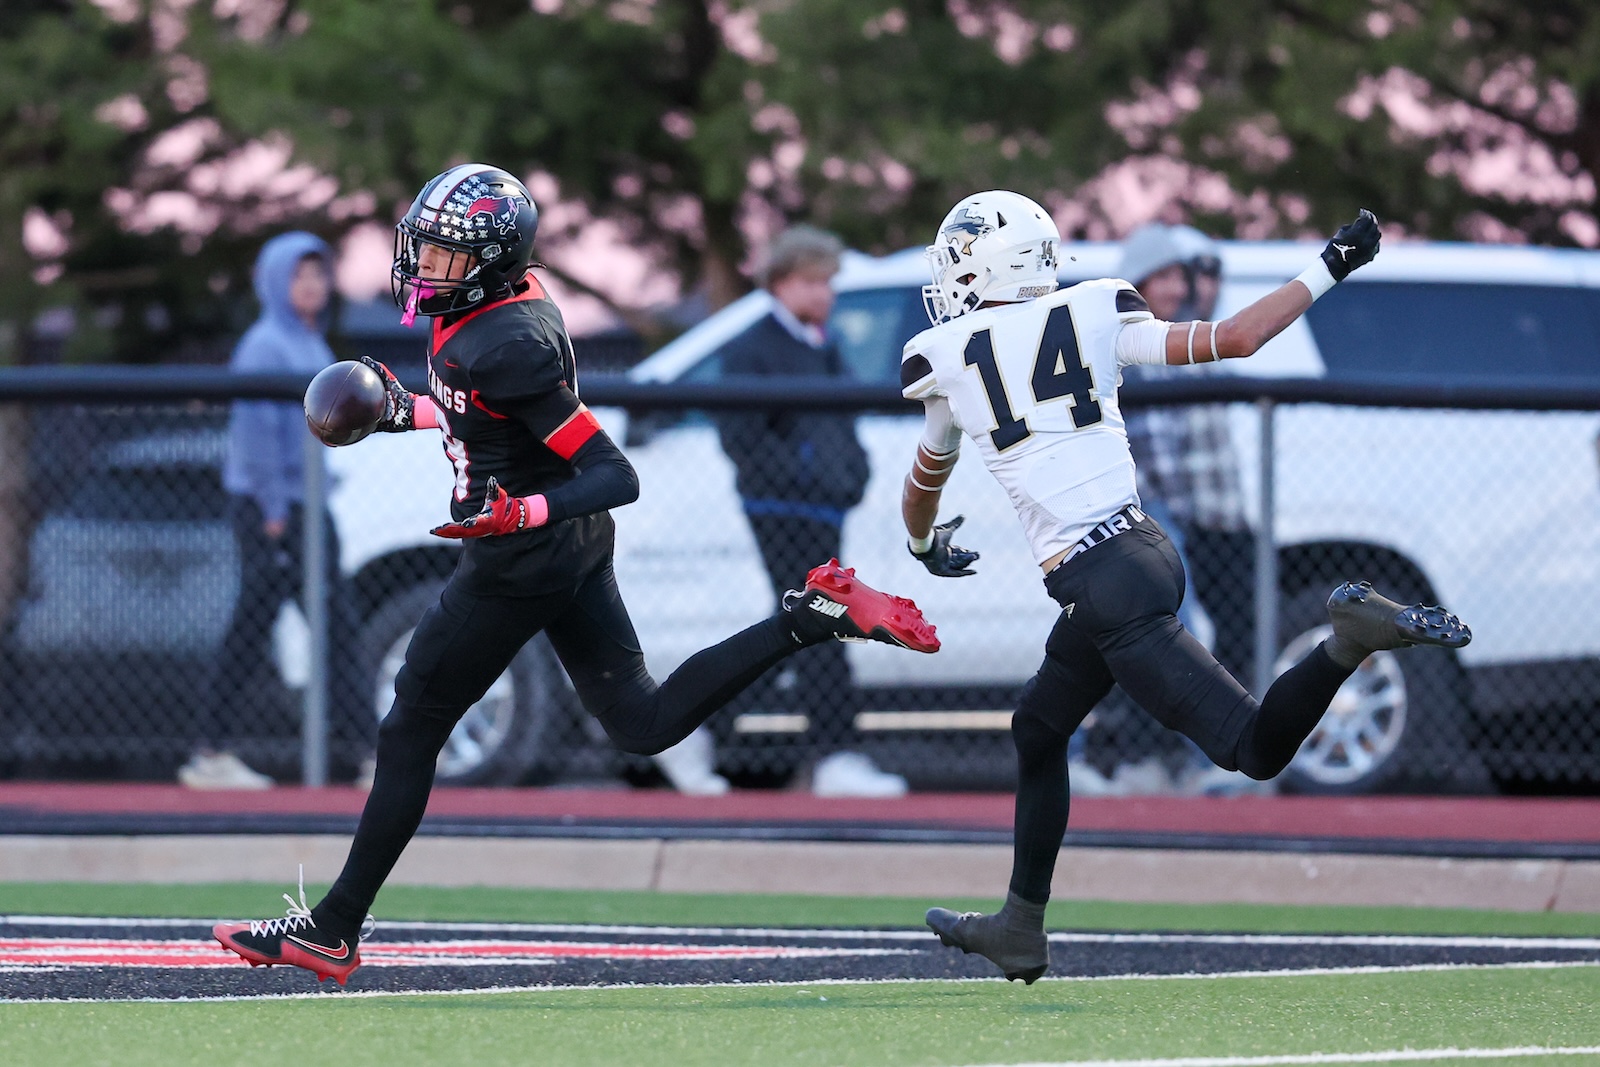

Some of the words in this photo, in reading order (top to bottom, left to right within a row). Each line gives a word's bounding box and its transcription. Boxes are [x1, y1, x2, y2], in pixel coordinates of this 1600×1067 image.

[1041, 240, 1053, 260] 14
[961, 302, 1103, 454] 14
[808, 594, 849, 619] NIKE
